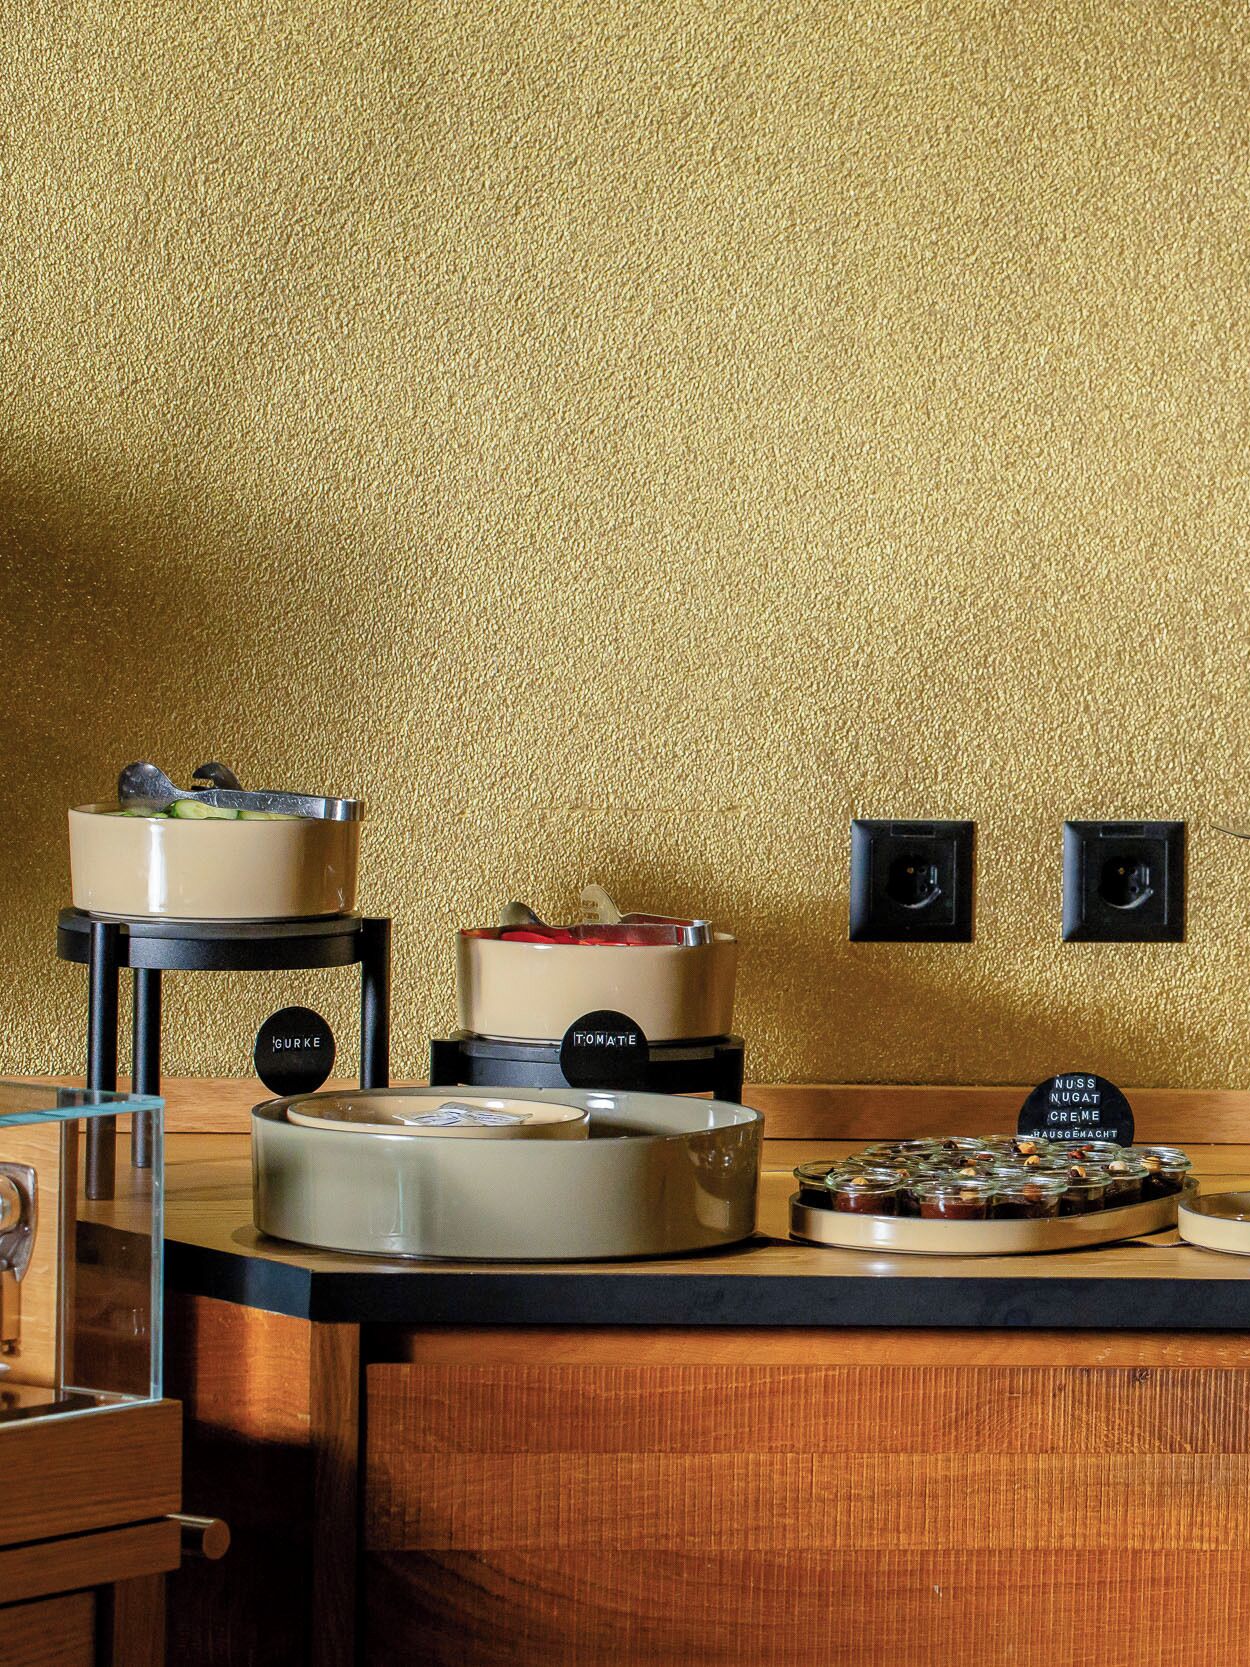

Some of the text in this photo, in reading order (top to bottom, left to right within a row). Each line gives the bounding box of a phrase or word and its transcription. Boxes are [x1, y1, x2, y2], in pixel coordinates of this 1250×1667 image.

[275, 1037, 321, 1049] GURKE
[575, 1034, 636, 1046] TOMATE
[1055, 1078, 1095, 1089] NUSS
[1051, 1092, 1100, 1104] NUGAT
[1050, 1110, 1099, 1122] CREME
[1033, 1130, 1118, 1138] HAUSGEMACHT
